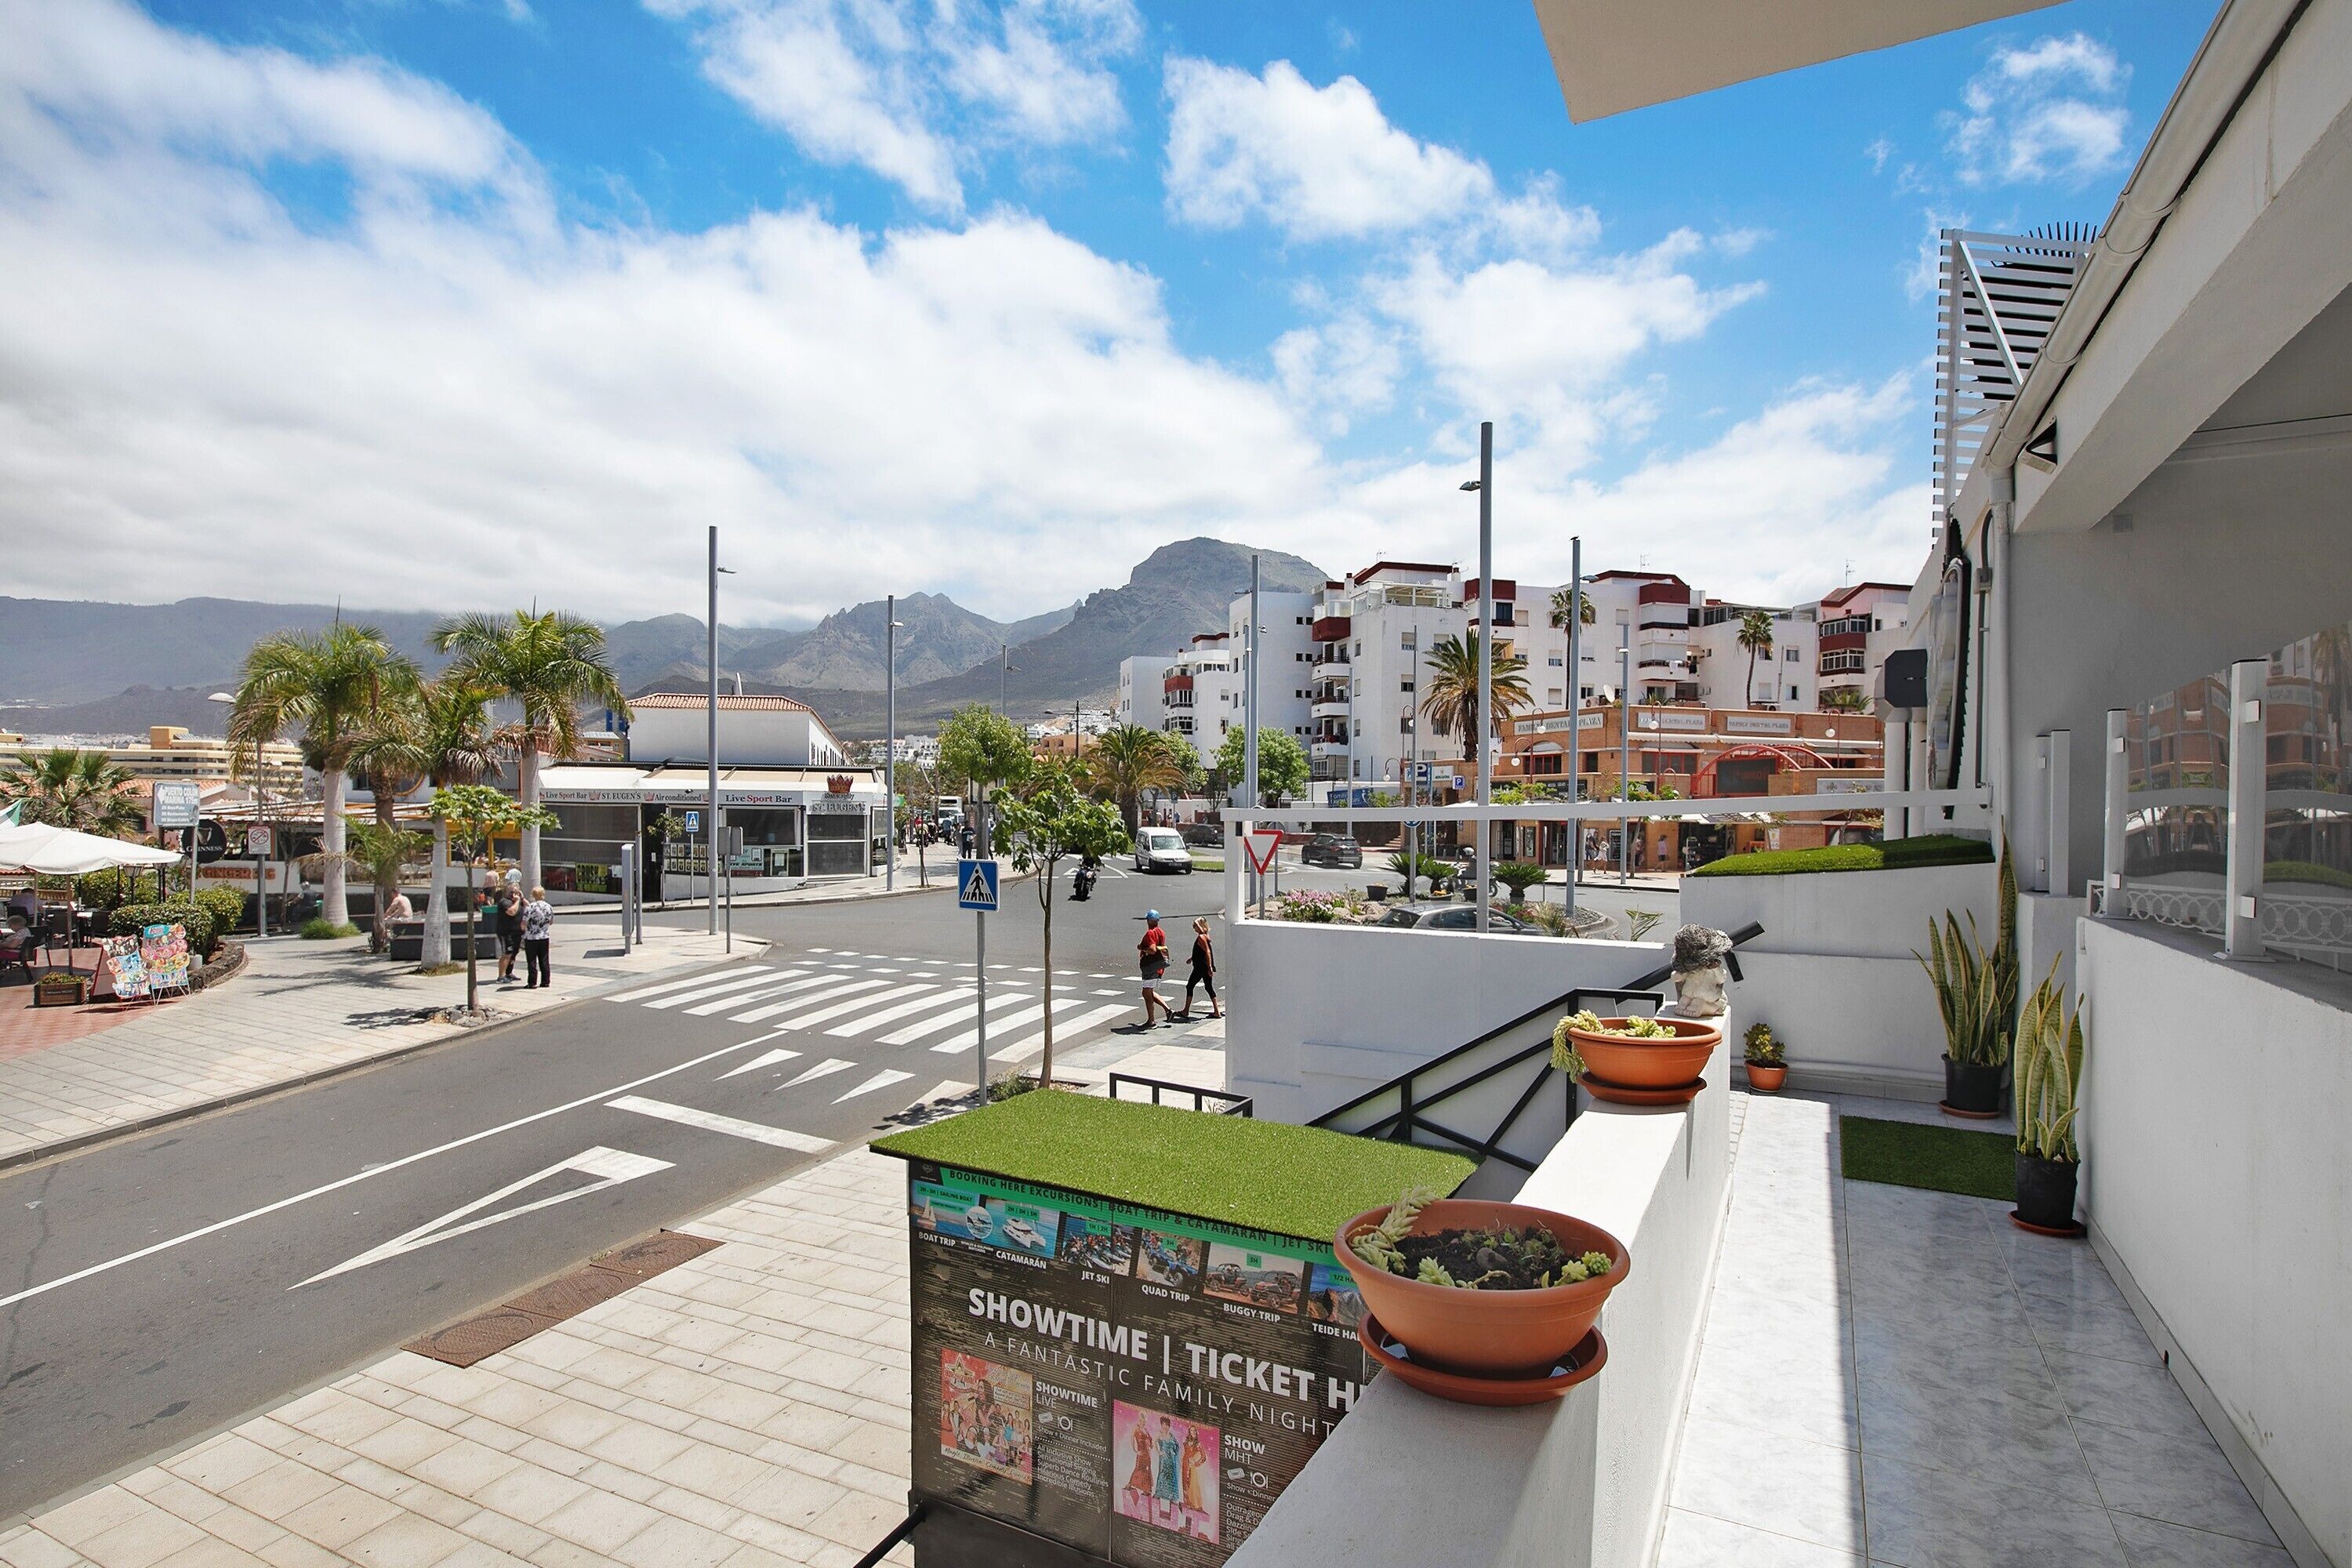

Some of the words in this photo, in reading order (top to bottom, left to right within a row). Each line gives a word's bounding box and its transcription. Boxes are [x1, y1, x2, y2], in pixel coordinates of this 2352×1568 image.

[1579, 717, 1602, 726] PLAZA
[1416, 764, 1427, 777] P
[165, 786, 183, 797] PUERTO
[559, 792, 575, 800] Sport
[746, 794, 773, 804] Sport
[165, 795, 185, 804] MARINA
[202, 867, 251, 880] GINGER
[939, 1191, 959, 1200] SAILING
[949, 1170, 996, 1188] BOOKING
[1000, 1181, 1026, 1193] HERE
[1109, 1202, 1139, 1216] BOAT
[1145, 1210, 1170, 1222] TRIP
[1174, 1214, 1184, 1225] &
[1282, 1234, 1301, 1249] JET
[1307, 1240, 1330, 1254] SKI
[1100, 1225, 1109, 1233] 2H
[919, 1232, 938, 1245] BOAT
[939, 1236, 956, 1247] TRIP
[1165, 1238, 1174, 1247] 3H
[996, 1250, 1047, 1270] CATAMARÁN
[1081, 1269, 1095, 1281] JET
[1095, 1272, 1110, 1285] SKI
[1141, 1283, 1168, 1298] QUAD
[1170, 1290, 1190, 1303] TRIP
[1223, 1303, 1258, 1319] BUGGY
[1258, 1310, 1281, 1323] TRIP
[1312, 1323, 1340, 1337] TEIDE
[968, 1287, 1149, 1361] SHOWTIME
[1185, 1342, 1316, 1402] TICKET
[1327, 1377, 1367, 1412] H
[984, 1332, 996, 1348] A
[1007, 1337, 1130, 1386] FANTASTIC
[1144, 1374, 1235, 1414] FAMILY
[1250, 1402, 1336, 1439] NIGHT
[1036, 1381, 1098, 1409] SHOWTIME
[1036, 1394, 1058, 1409] LIVE
[1037, 1425, 1054, 1436] Show
[1059, 1432, 1080, 1443] Dinner
[1080, 1439, 1107, 1452] Included
[1224, 1433, 1265, 1455] SHOW
[1037, 1450, 1073, 1468] Sensational
[1073, 1463, 1097, 1478] Singing
[1046, 1446, 1073, 1461] Inclusive
[1073, 1456, 1092, 1467] Show
[1225, 1449, 1253, 1465] MHT
[1037, 1458, 1060, 1472] Superb
[1060, 1466, 1080, 1478] Dance
[1081, 1473, 1109, 1488] Routines
[1037, 1466, 1065, 1481] Hilarious
[1065, 1475, 1092, 1490] Comedy
[1037, 1474, 1068, 1489] Incredible
[1068, 1483, 1094, 1497] Illusions
[1226, 1482, 1247, 1494] Show
[1252, 1490, 1276, 1502] Dinner
[1226, 1510, 1244, 1523] Drag
[1245, 1515, 1251, 1524] &
[1226, 1518, 1254, 1532] Dazzlin
[1226, 1526, 1242, 1536] Side
[1226, 1534, 1244, 1546] Sing
